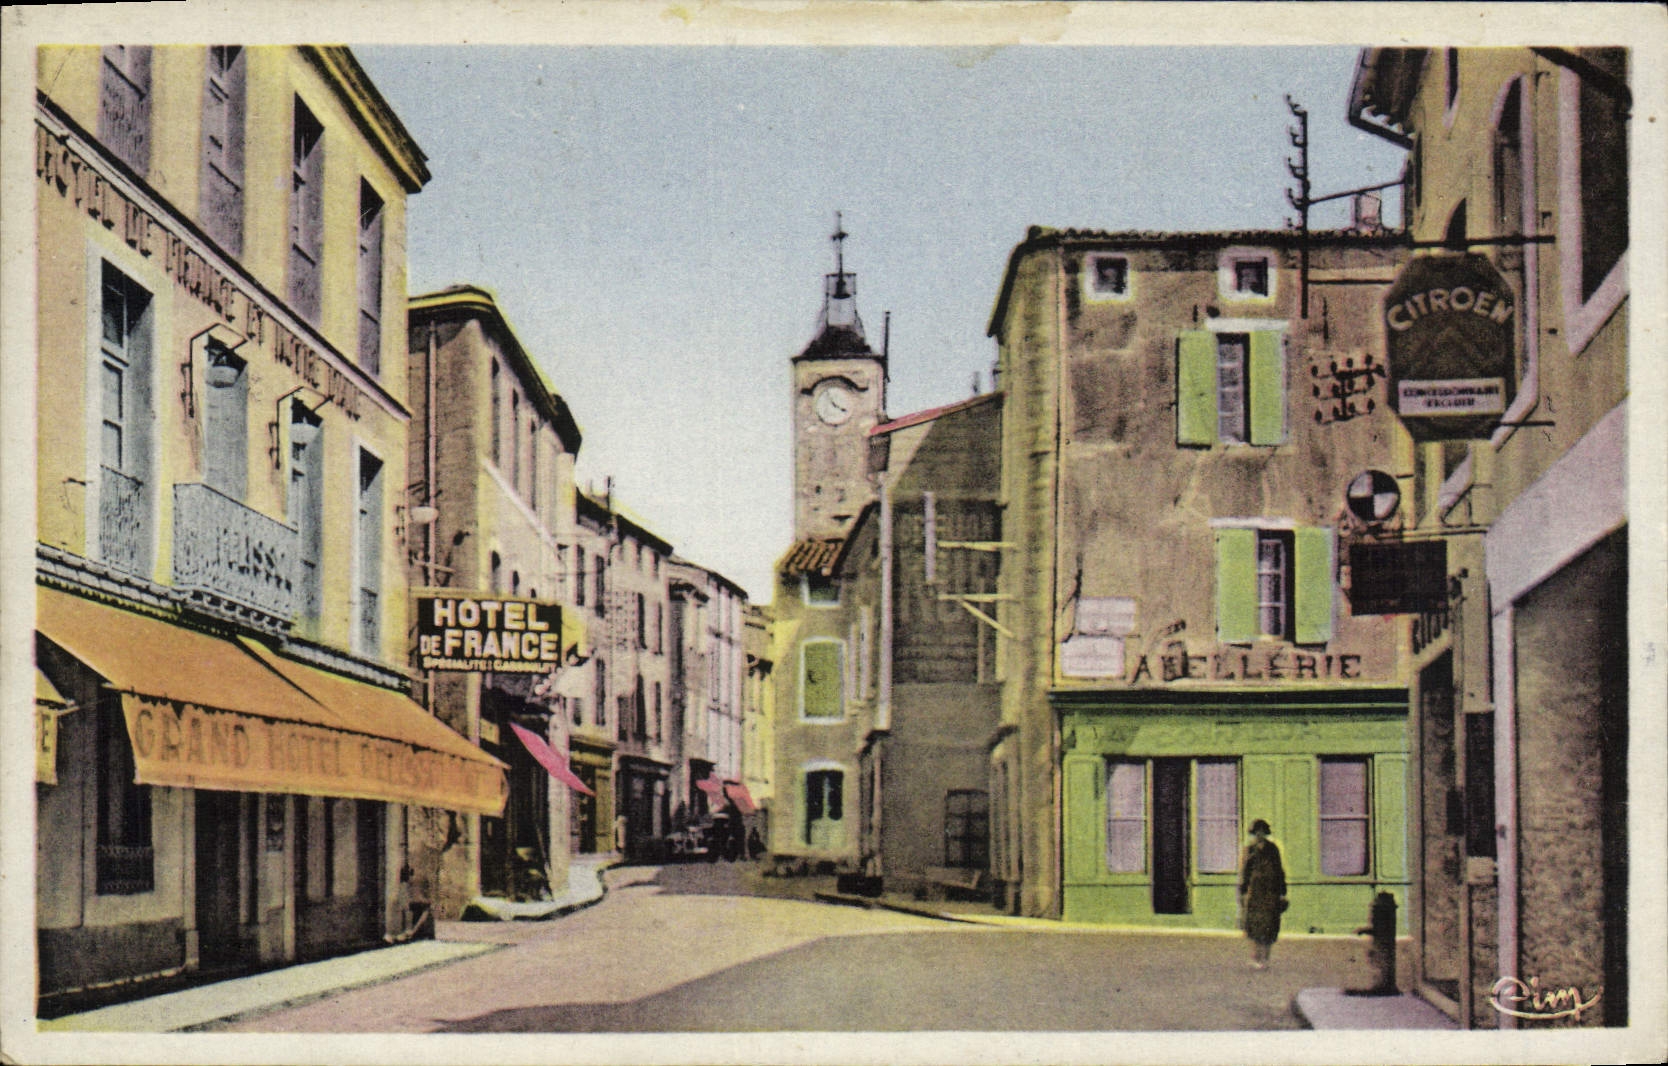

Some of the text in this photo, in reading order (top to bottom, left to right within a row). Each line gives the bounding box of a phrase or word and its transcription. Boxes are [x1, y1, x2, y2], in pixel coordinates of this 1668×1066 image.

[125, 199, 152, 258] DE
[166, 231, 236, 323] FRANCE
[1387, 286, 1514, 332] CITROEN
[420, 629, 559, 661] DE FRANCE
[135, 709, 250, 768] GRAND
